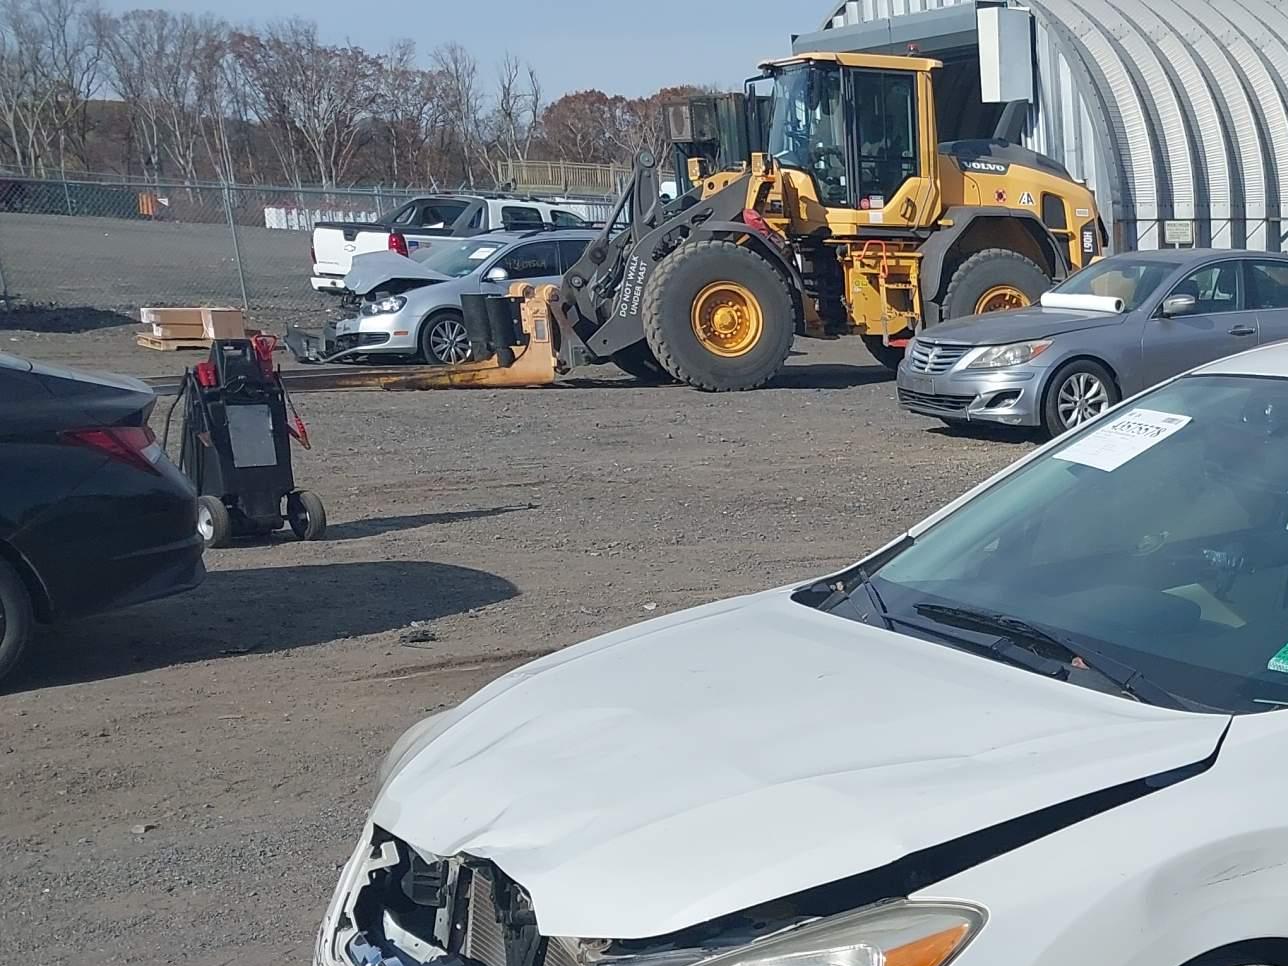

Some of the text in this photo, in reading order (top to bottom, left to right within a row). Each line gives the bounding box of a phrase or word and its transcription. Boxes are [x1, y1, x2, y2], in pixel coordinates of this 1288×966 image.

[961, 161, 1006, 171] VOLVO
[1083, 231, 1093, 252] L90H
[619, 255, 639, 317] DO NOT WALK
[630, 260, 647, 315] UNDER MAST
